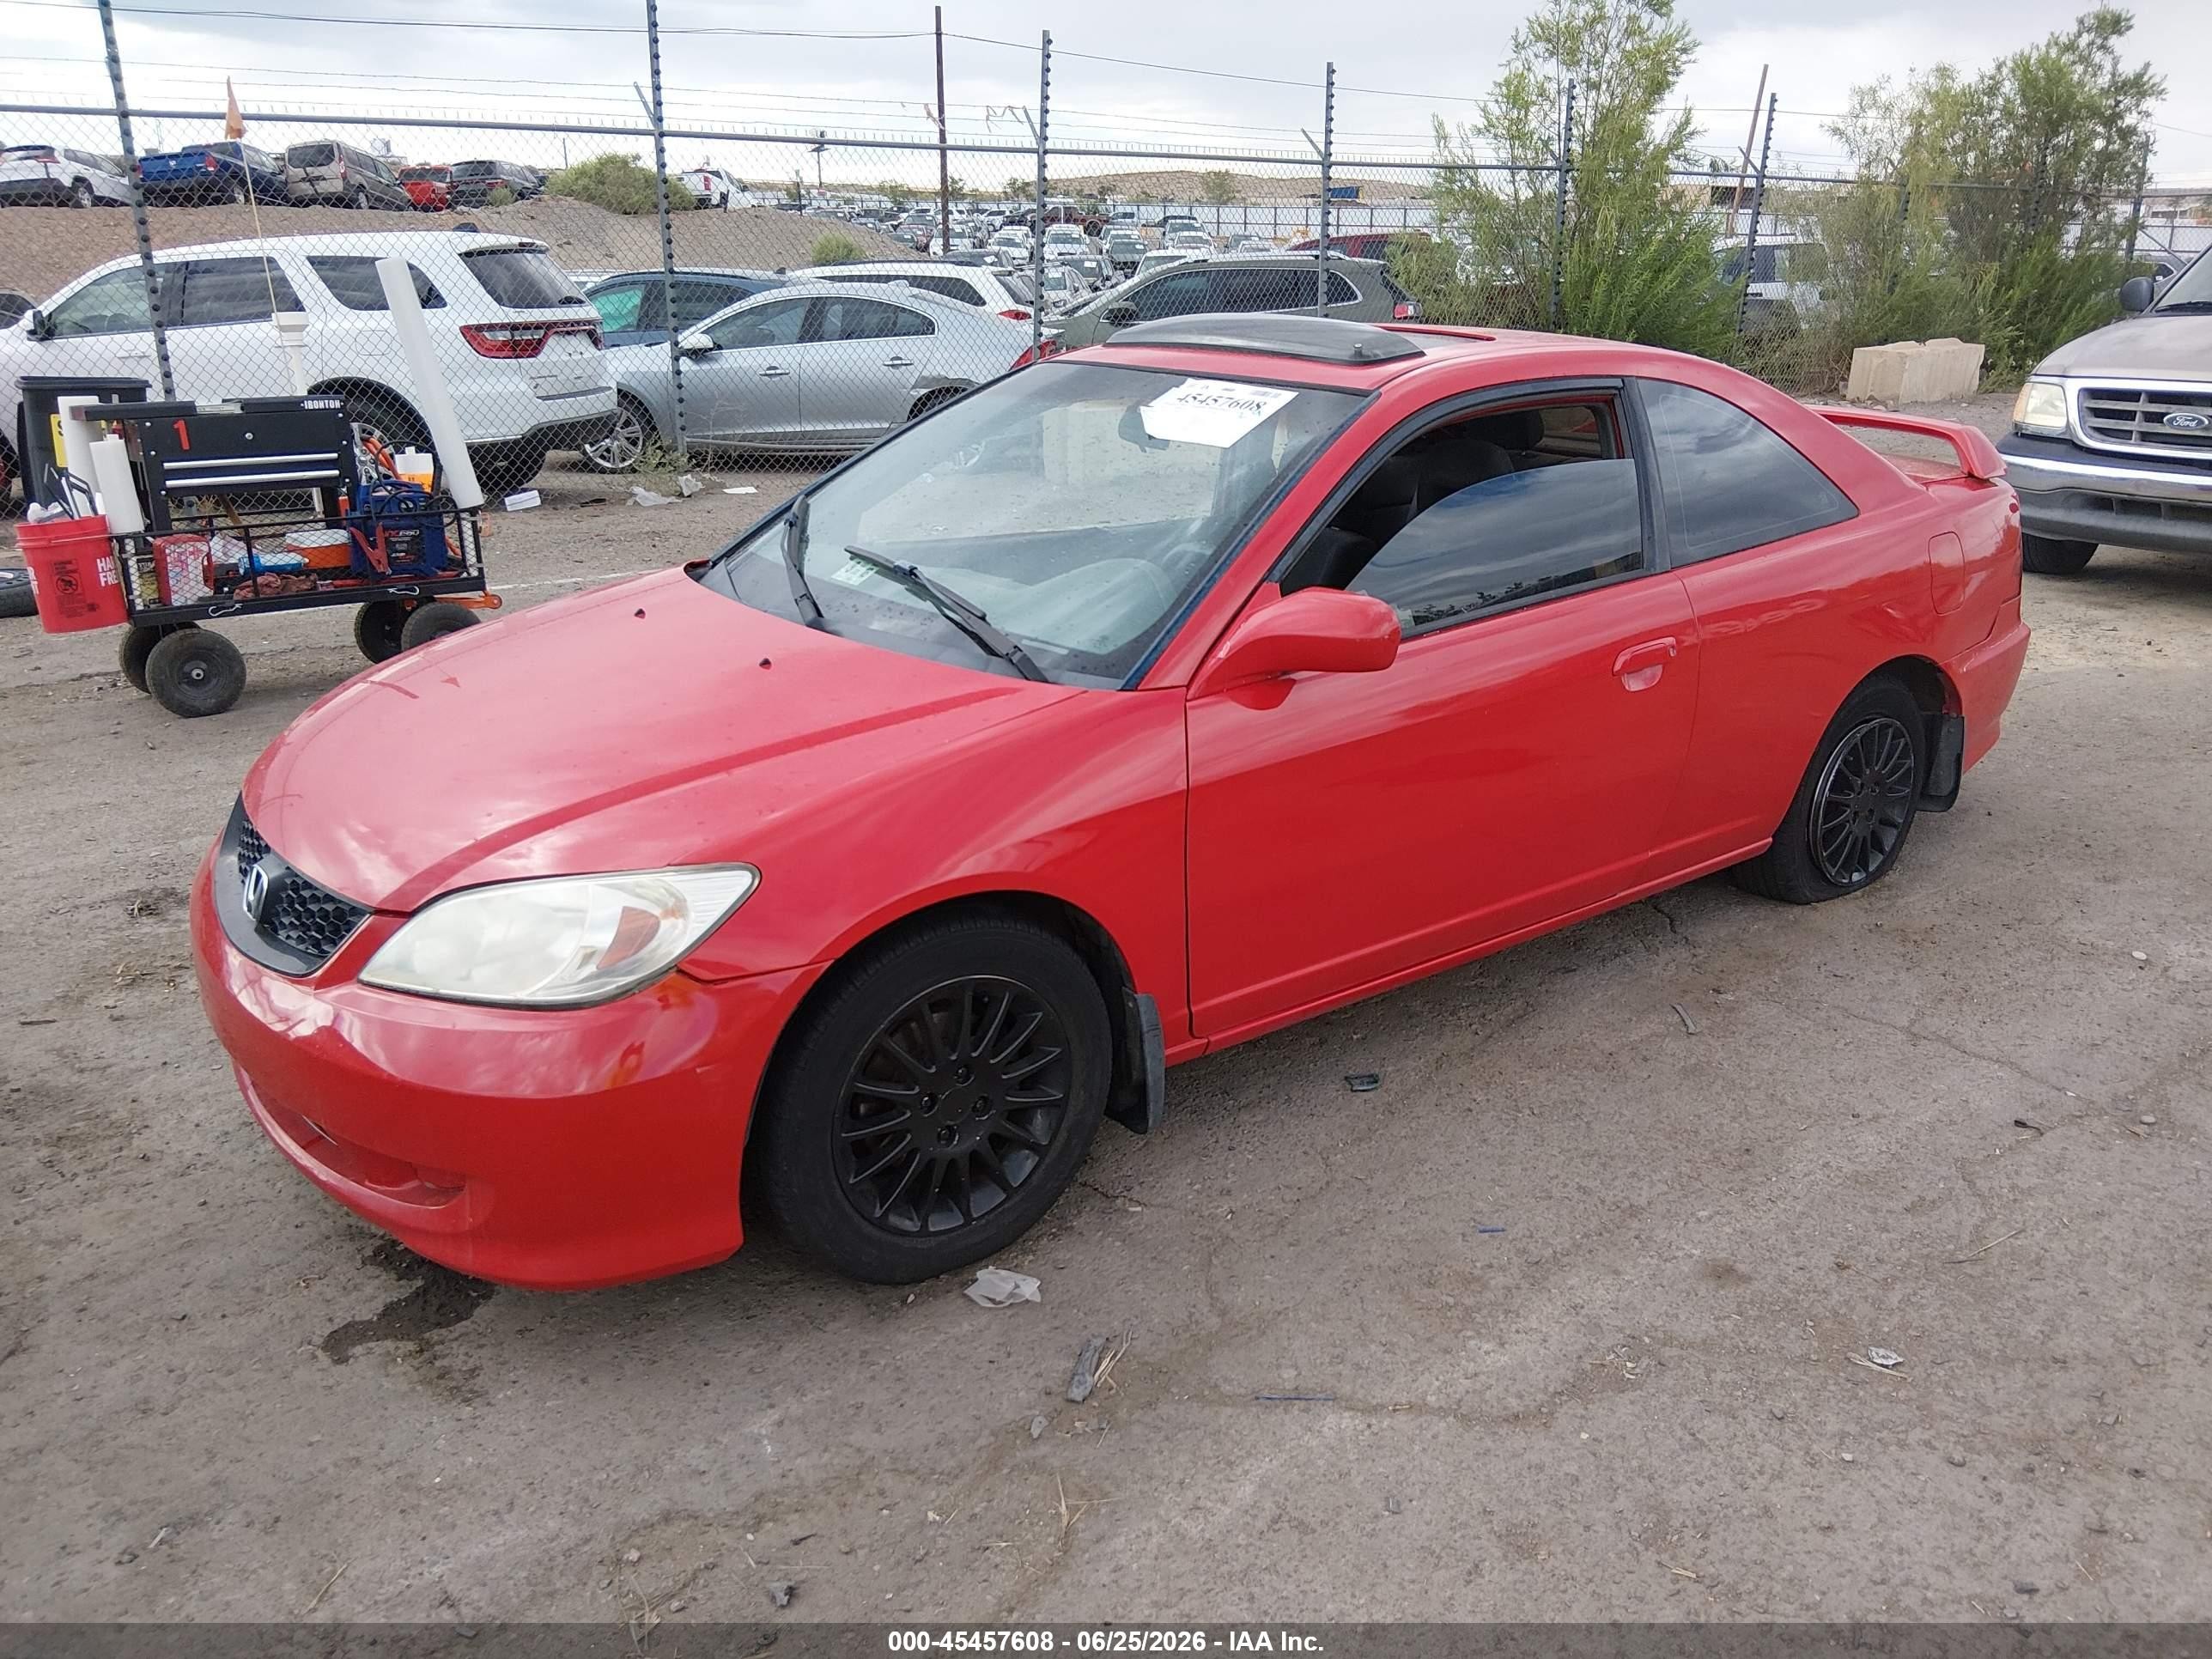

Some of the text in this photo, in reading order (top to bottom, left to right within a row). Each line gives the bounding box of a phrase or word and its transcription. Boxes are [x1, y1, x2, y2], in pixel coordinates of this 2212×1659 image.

[1177, 393, 1267, 410] 45457608
[2173, 416, 2198, 427] Ford
[173, 419, 190, 451] 1
